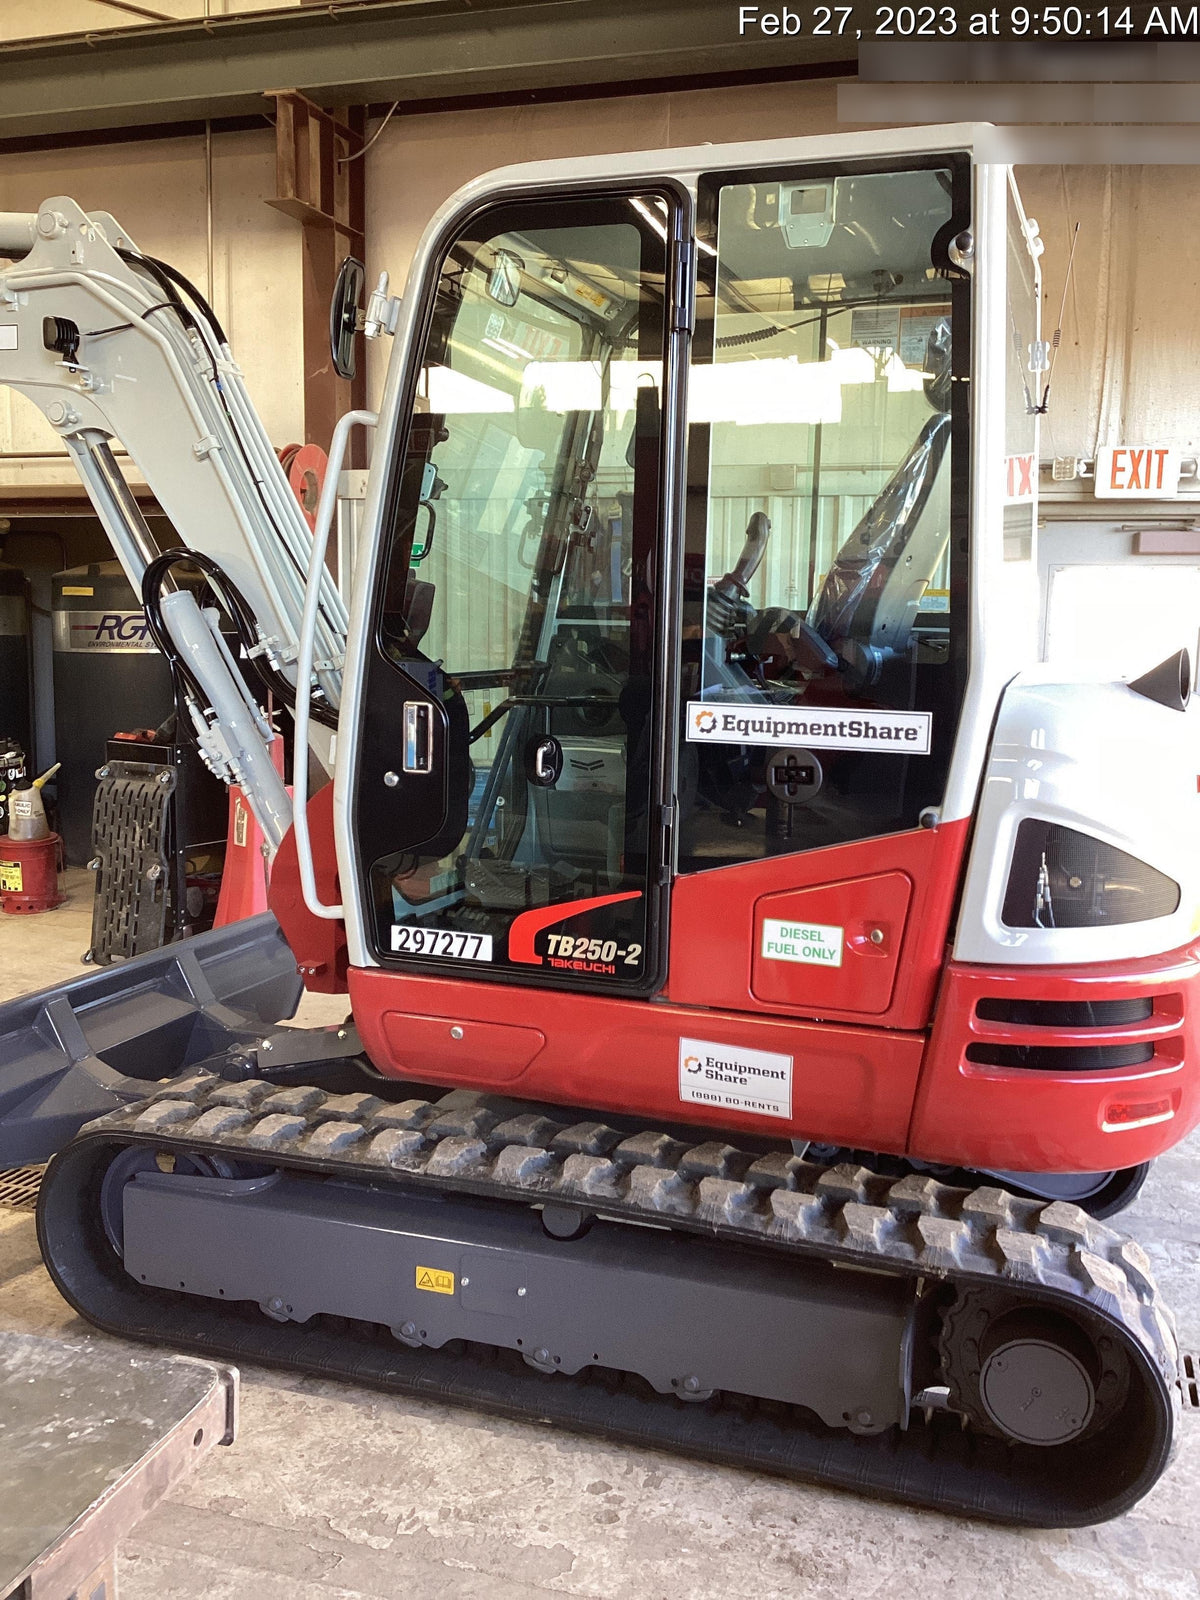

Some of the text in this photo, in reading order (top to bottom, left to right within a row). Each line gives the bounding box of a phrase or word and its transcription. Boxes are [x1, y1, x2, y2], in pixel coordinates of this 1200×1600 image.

[1109, 449, 1170, 490] EXIT
[721, 713, 919, 742] EquipmentShare
[397, 927, 484, 959] 297277
[780, 926, 825, 943] DIESEL
[547, 934, 642, 966] TB250-2
[766, 941, 837, 960] FUEL ONLY
[547, 957, 616, 974] TAKEUCHI
[705, 1056, 787, 1081] Equipment
[705, 1069, 748, 1086] Share
[691, 1090, 780, 1112] (888) 80-RENTS
